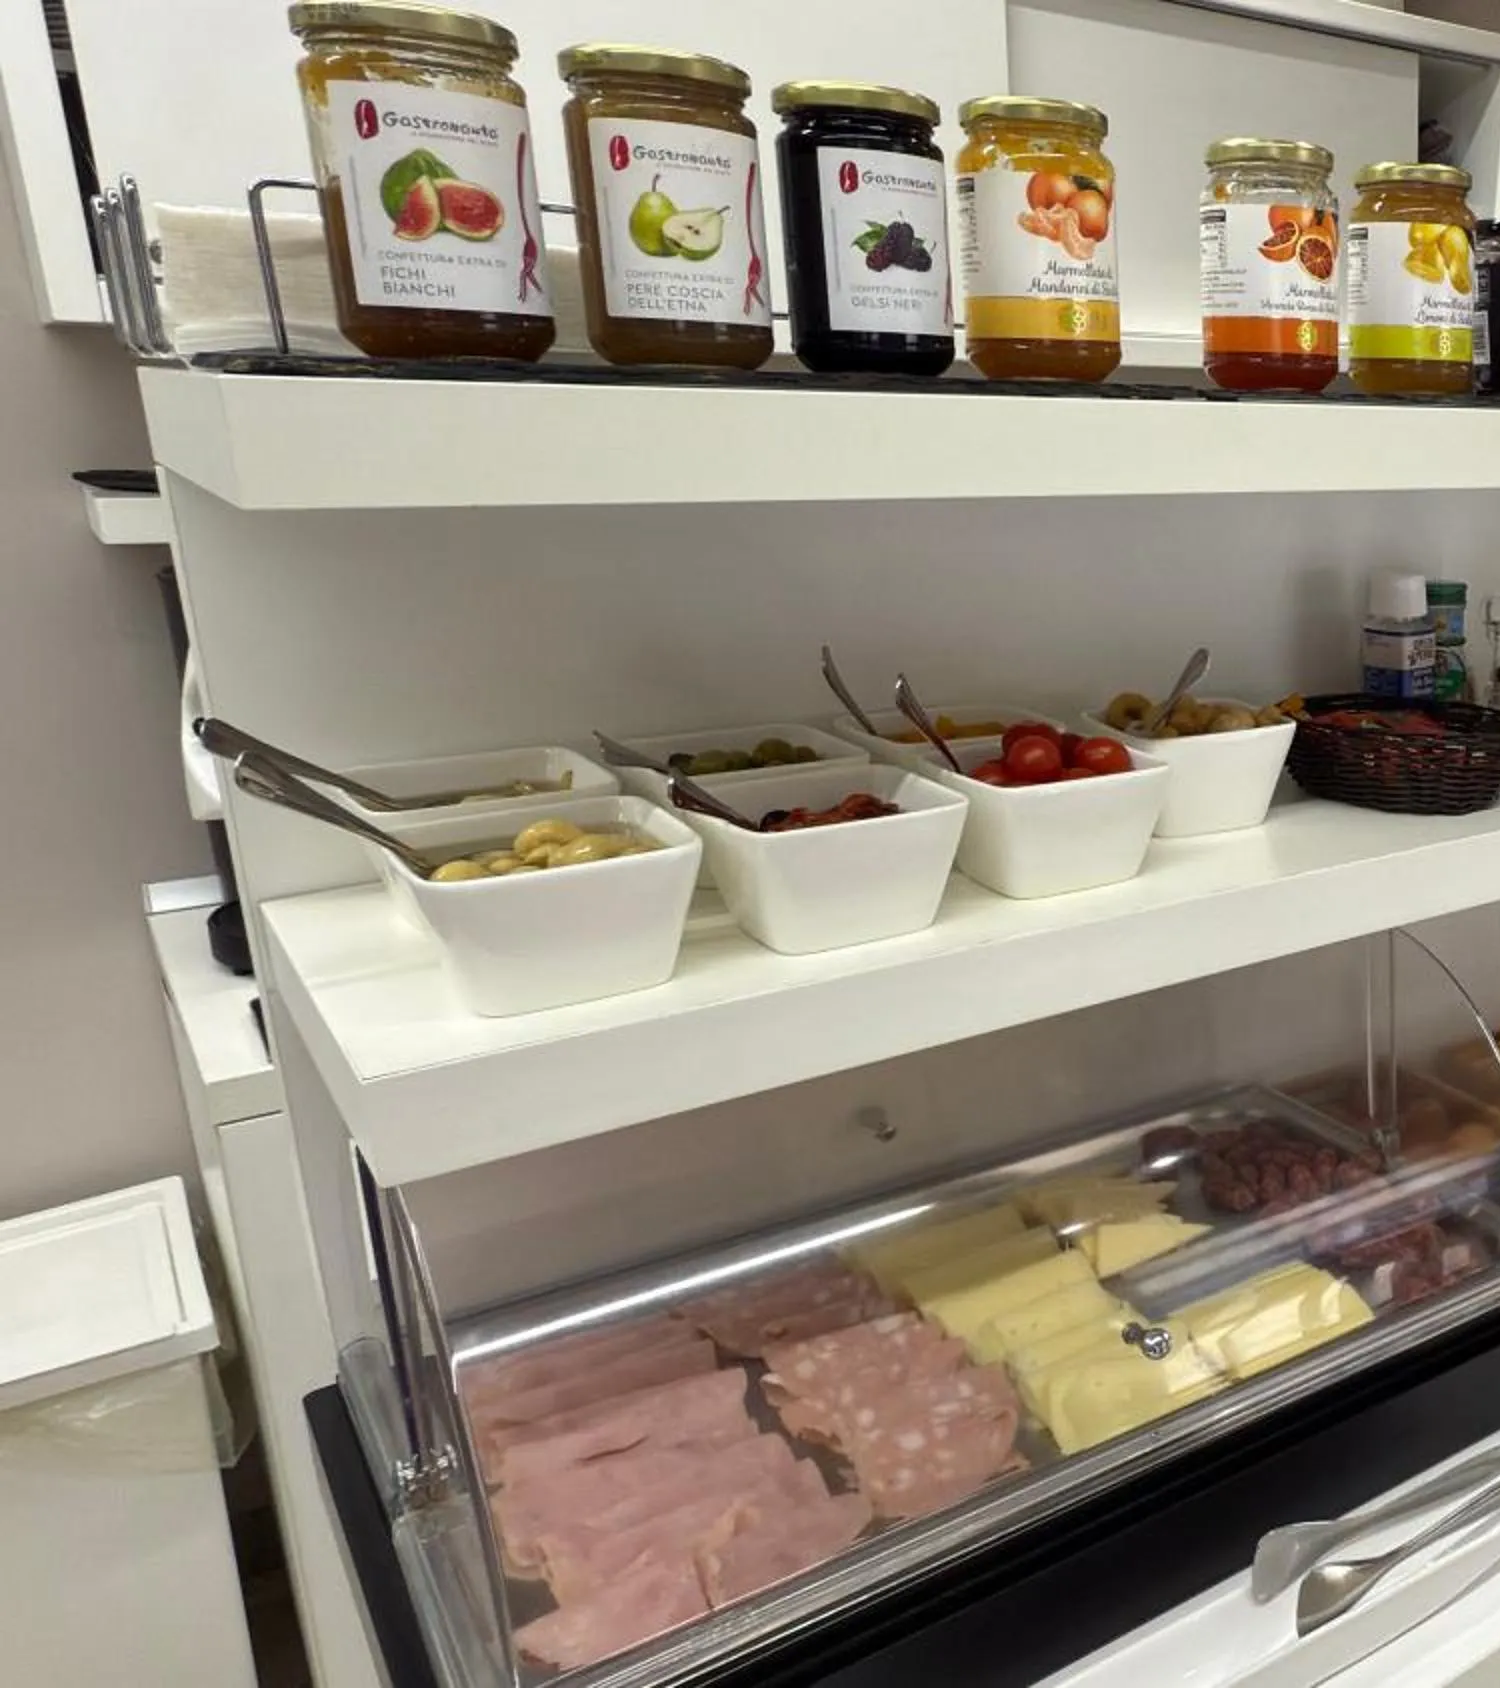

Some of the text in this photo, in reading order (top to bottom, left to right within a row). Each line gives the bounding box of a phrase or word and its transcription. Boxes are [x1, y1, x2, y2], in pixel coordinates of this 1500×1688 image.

[380, 266, 427, 281] FICHI
[383, 282, 456, 298] BIANCHI
[626, 283, 726, 300] PERE COSCIA
